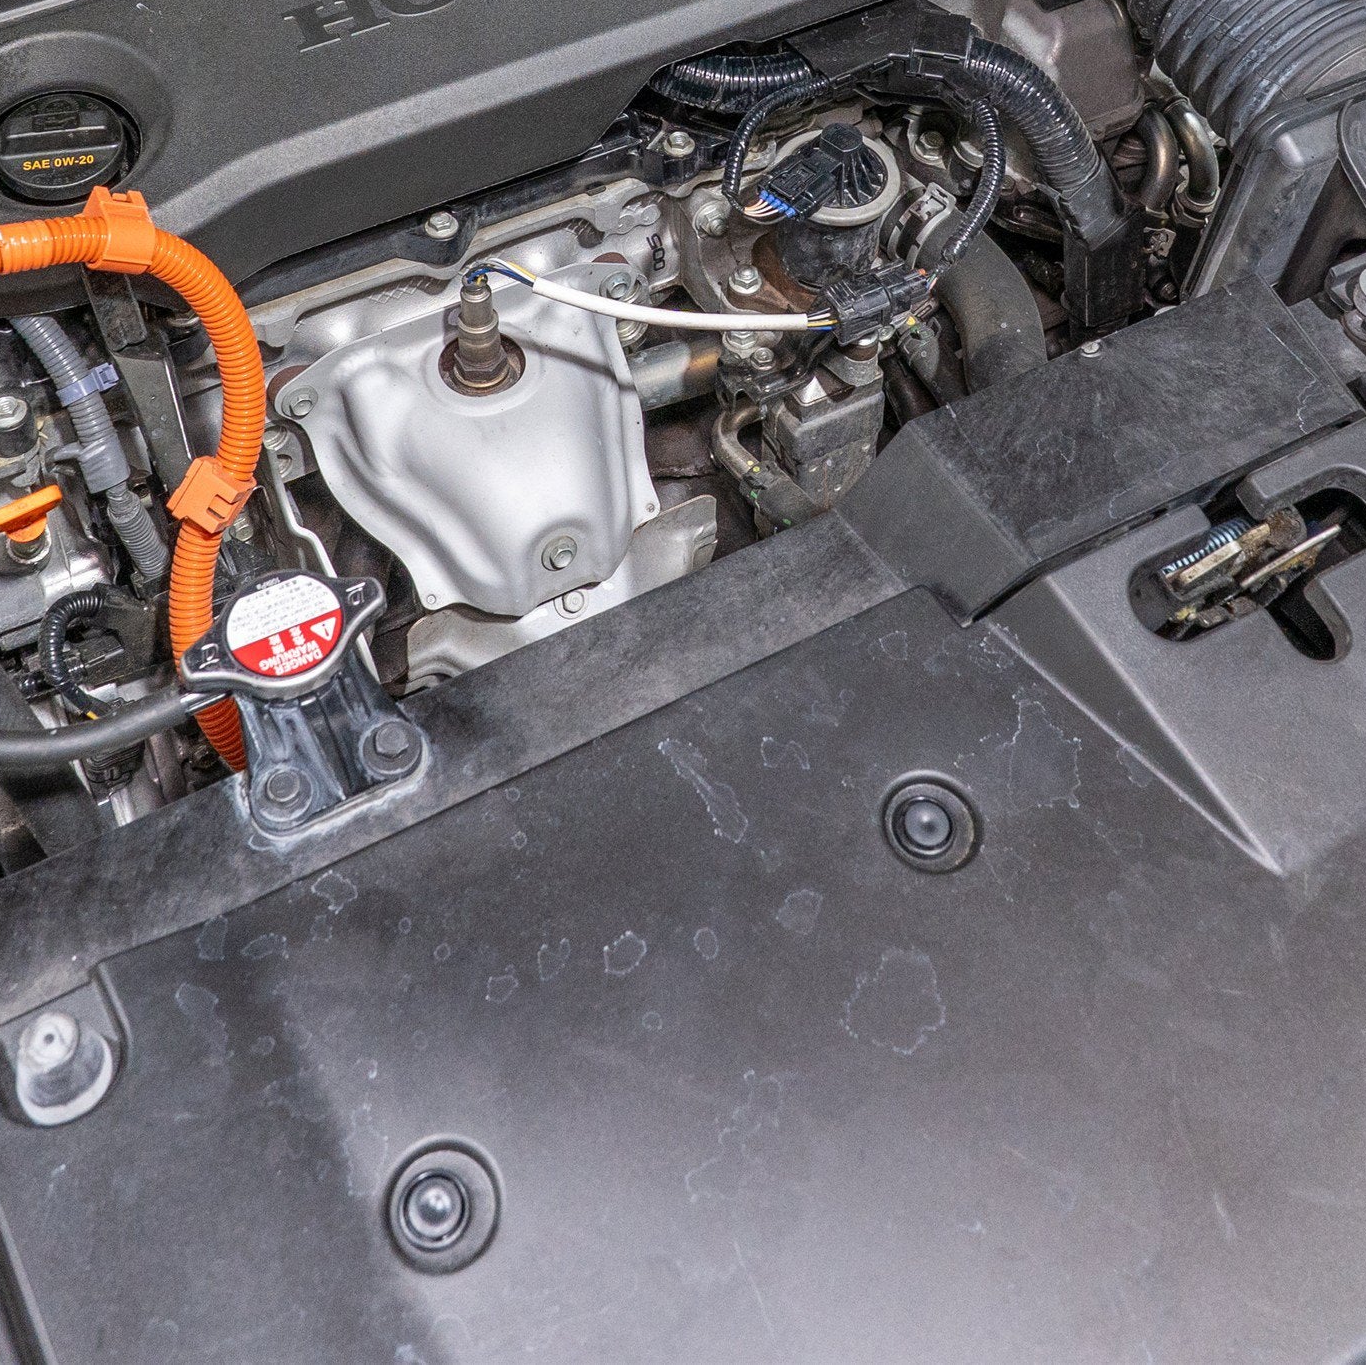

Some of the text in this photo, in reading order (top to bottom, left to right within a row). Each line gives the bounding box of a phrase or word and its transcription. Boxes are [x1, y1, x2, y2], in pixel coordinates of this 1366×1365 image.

[23, 154, 95, 171] SAE 0W-20
[258, 639, 319, 672] WARNUNG
[274, 648, 324, 676] DANGER
